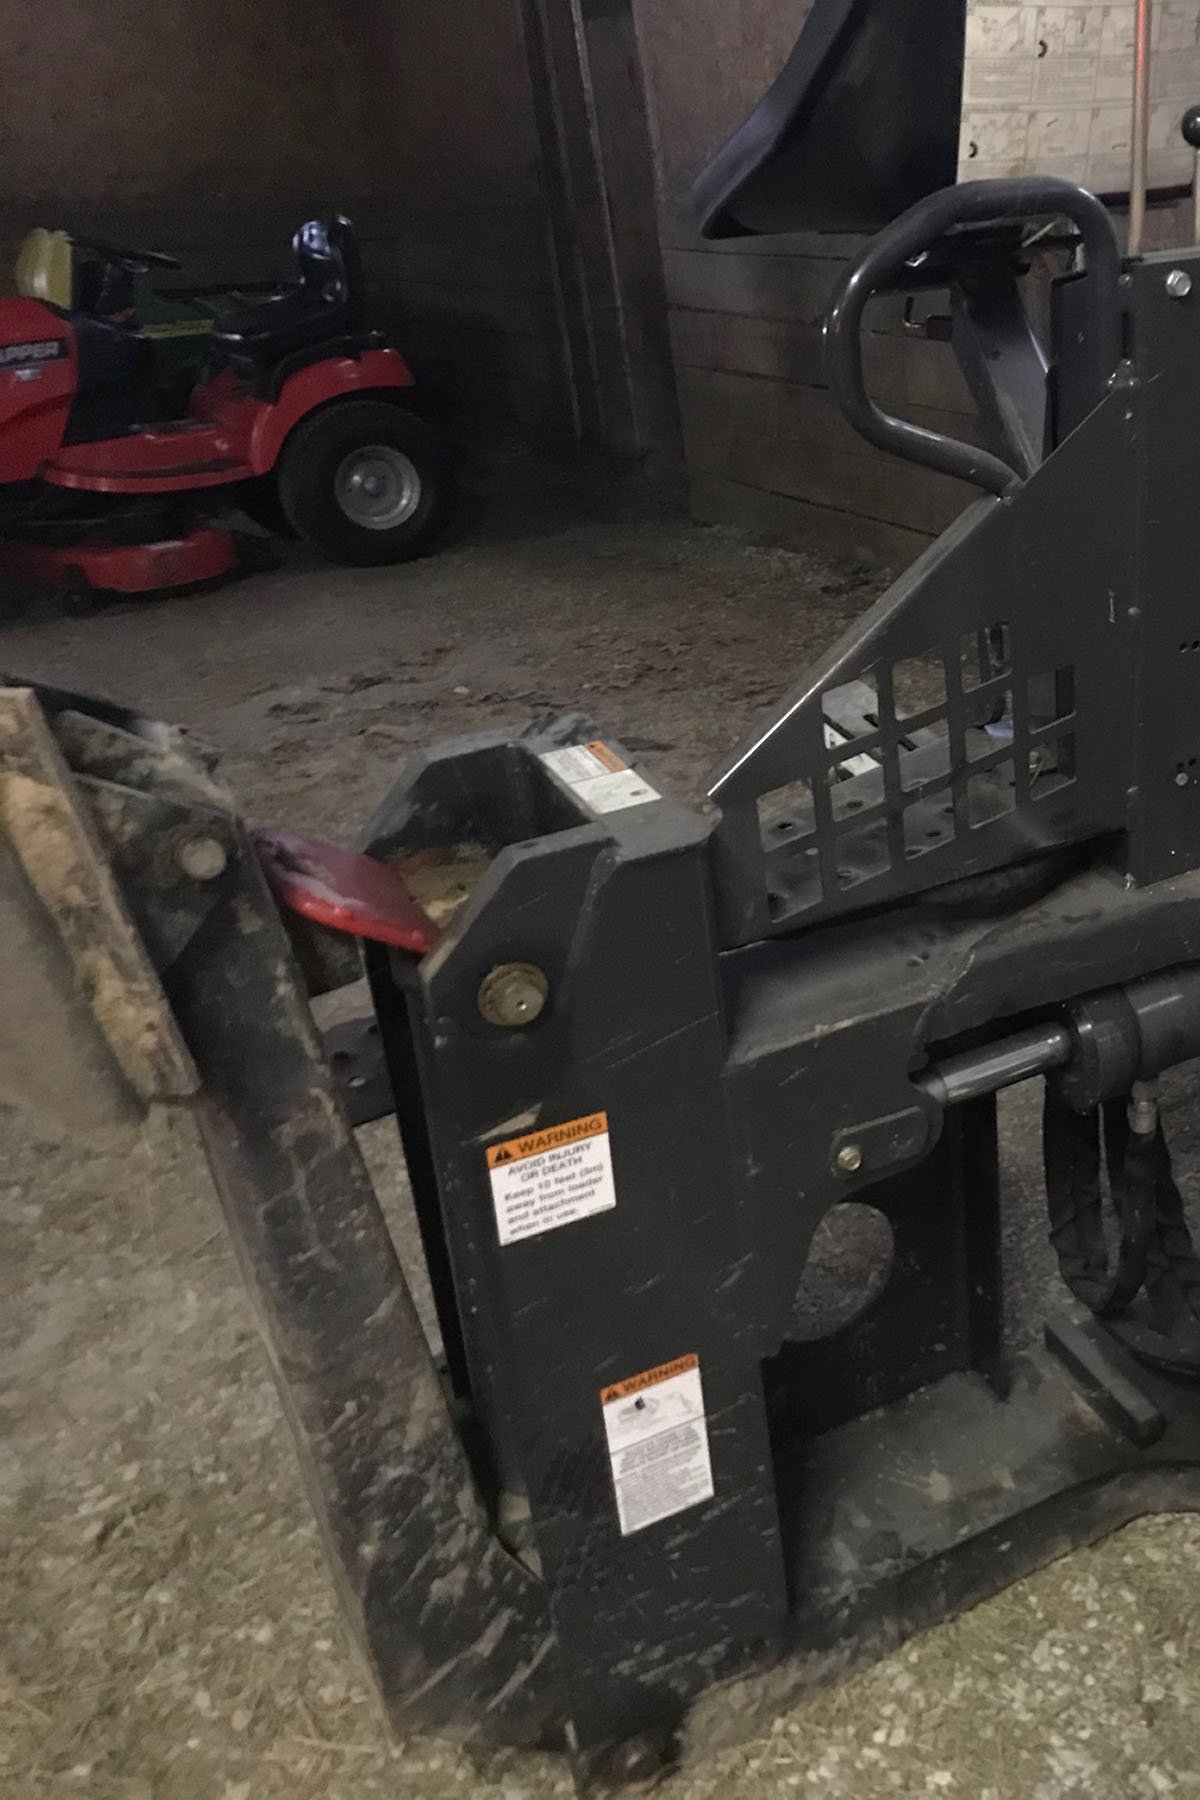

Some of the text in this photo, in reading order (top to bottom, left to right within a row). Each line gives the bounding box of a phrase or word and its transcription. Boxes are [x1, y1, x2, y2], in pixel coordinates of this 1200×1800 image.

[518, 1118, 602, 1153] WARNING
[508, 1142, 592, 1176] AVOID INJURY
[521, 1156, 582, 1183] OR DEATH
[505, 1186, 534, 1201] Keep
[554, 1171, 576, 1185] feet
[506, 1175, 603, 1213] away from loader
[508, 1211, 529, 1224] and
[533, 1189, 595, 1216] attachment
[510, 1221, 539, 1235] when
[622, 1356, 696, 1392] WARNING
